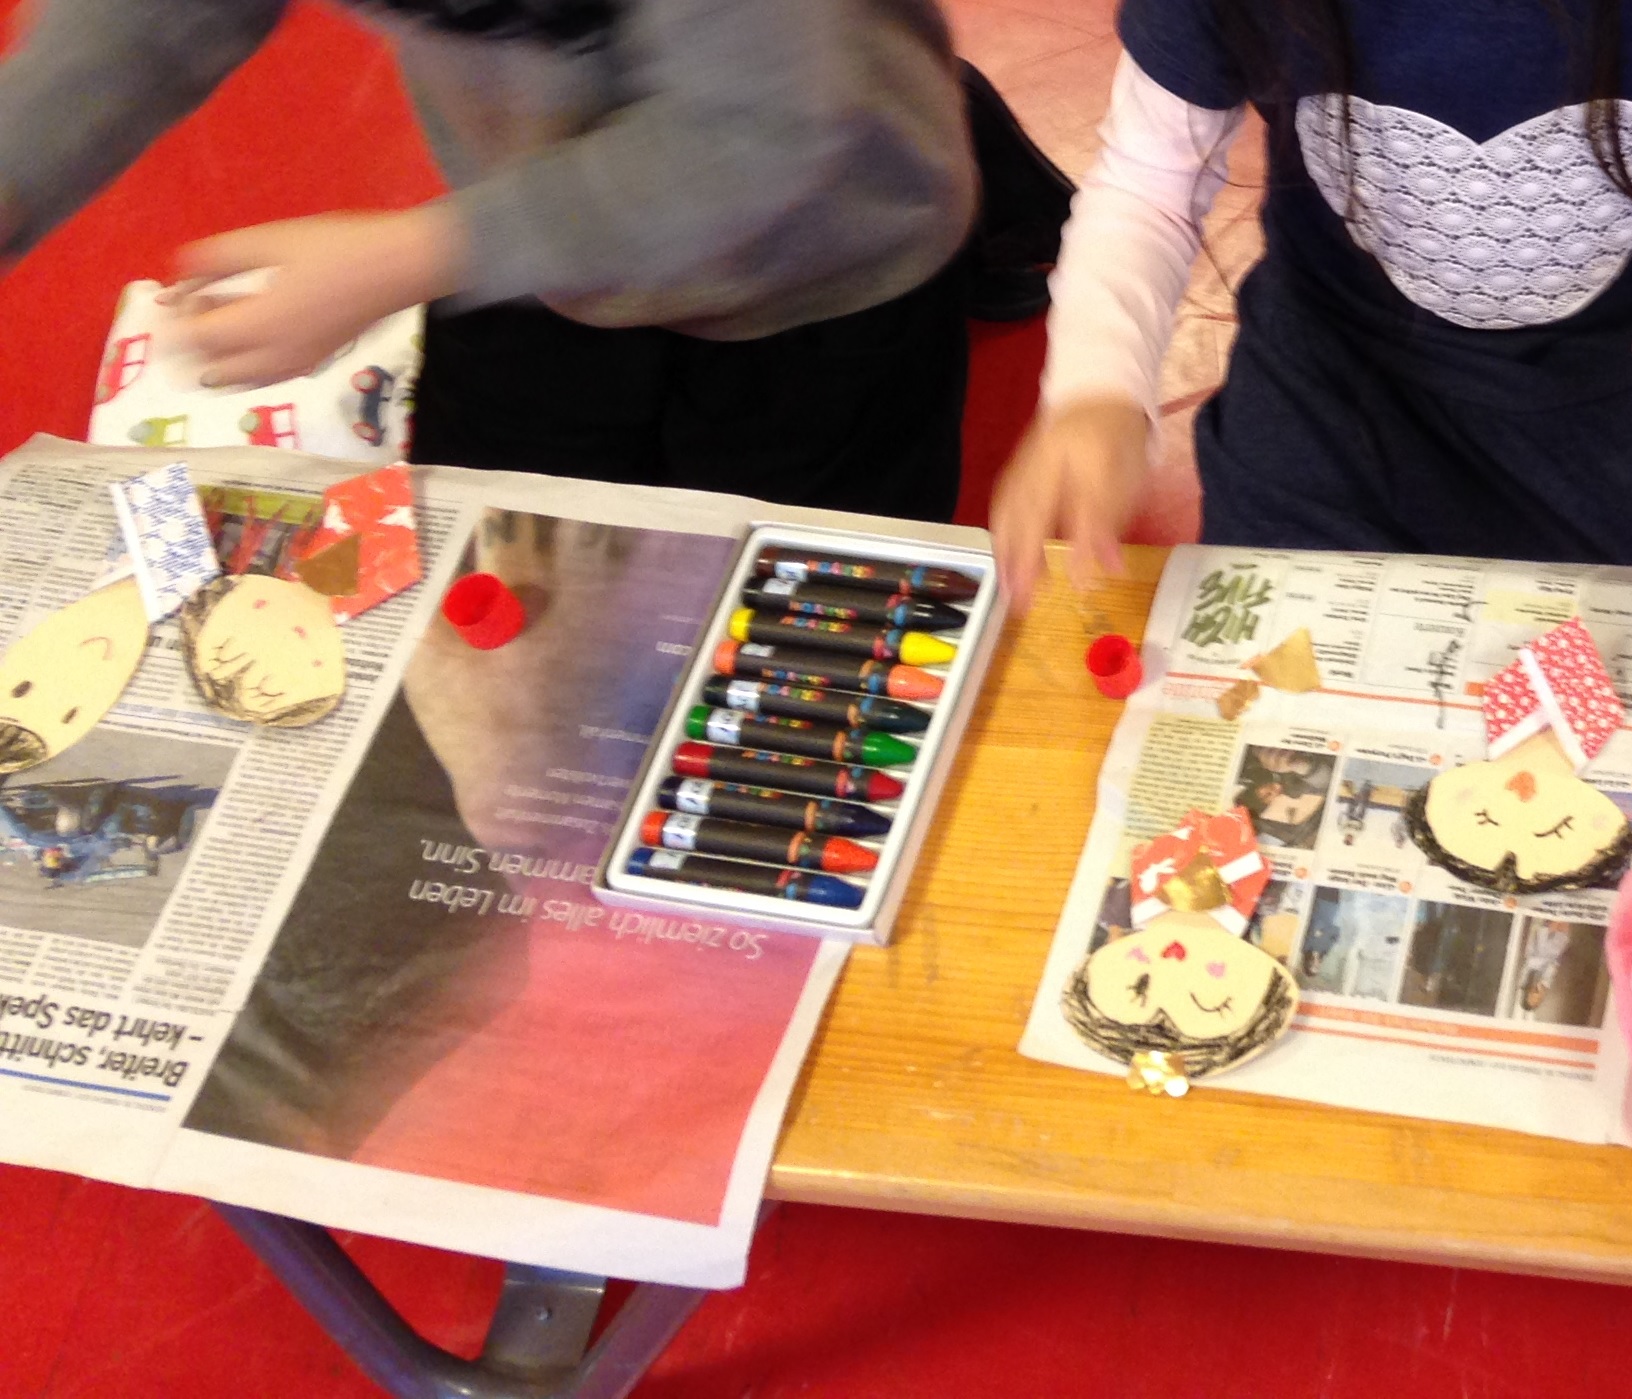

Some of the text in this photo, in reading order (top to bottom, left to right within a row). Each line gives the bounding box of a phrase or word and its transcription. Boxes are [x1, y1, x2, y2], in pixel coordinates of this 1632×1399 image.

[420, 837, 598, 886] ammen Sinn.
[409, 878, 771, 960] So ziemlich alles im Leben
[63, 1005, 112, 1038] das
[113, 1014, 187, 1051] kehrt
[0, 1030, 190, 1088] Breiter, schnitt
